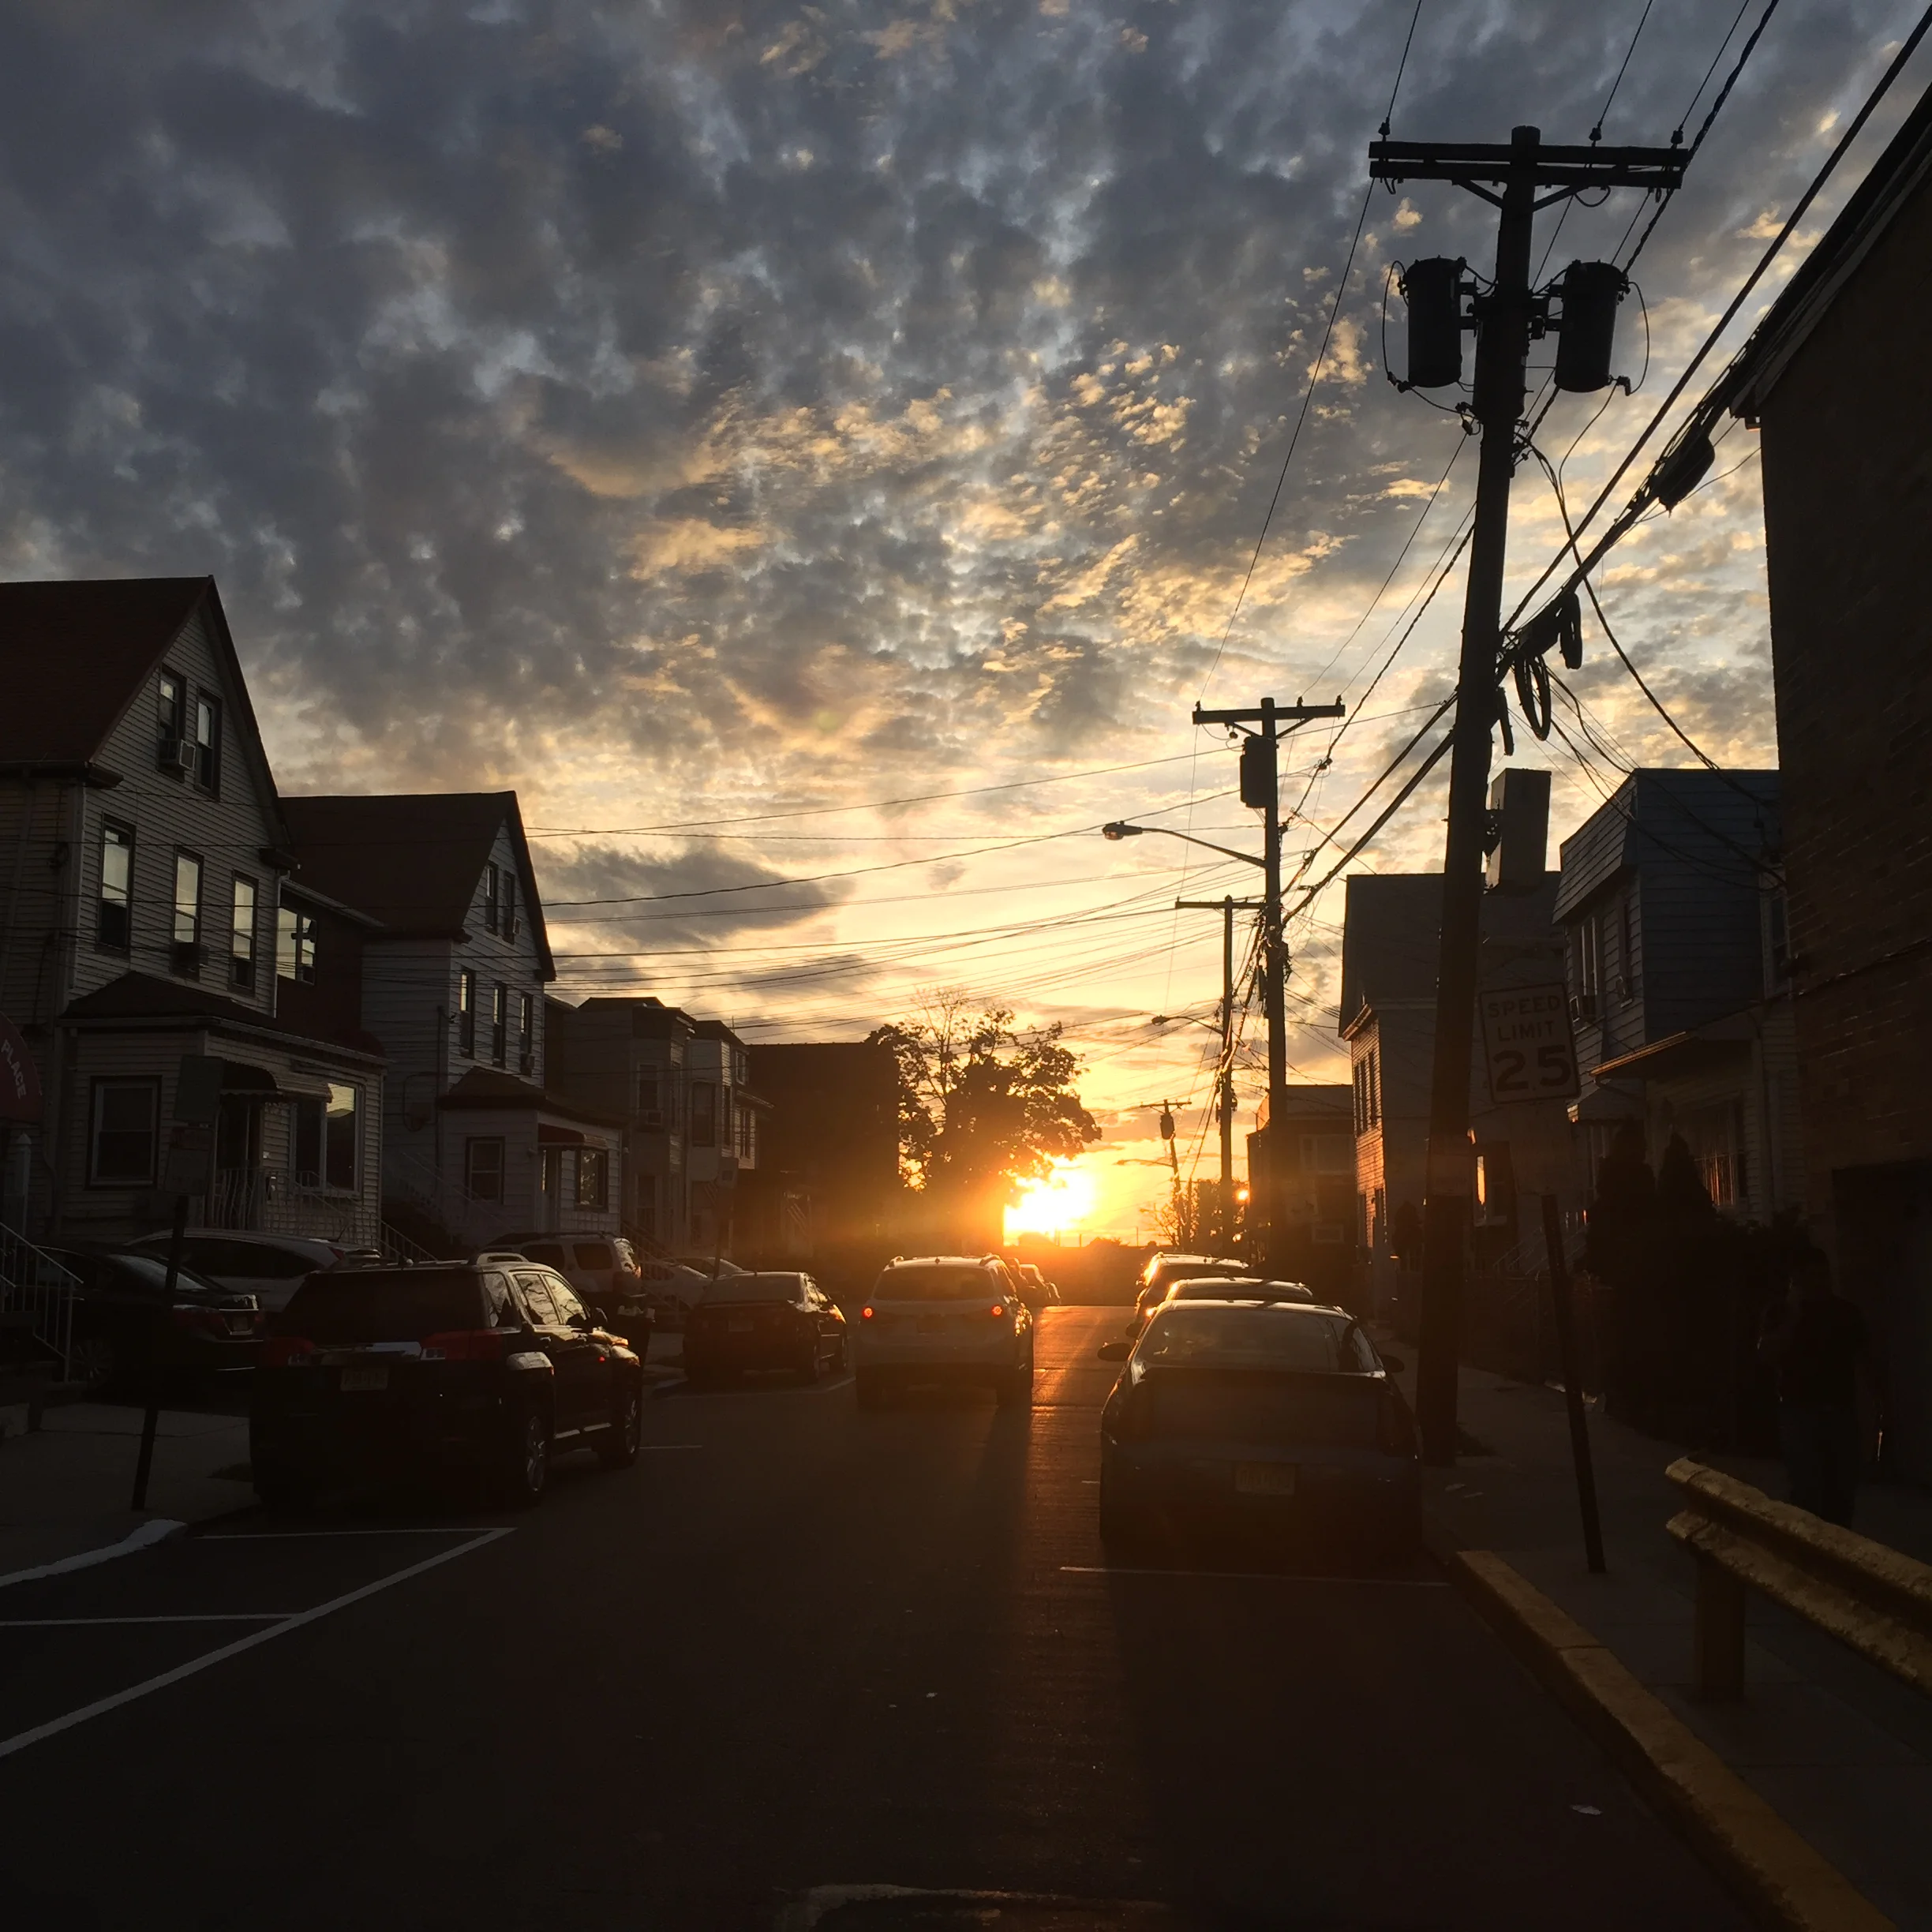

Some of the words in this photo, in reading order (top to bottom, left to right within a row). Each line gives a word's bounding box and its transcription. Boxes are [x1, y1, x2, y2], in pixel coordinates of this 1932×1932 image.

[1488, 995, 1560, 1017] SPEED
[1498, 1021, 1554, 1042] LIMIT
[1, 1039, 27, 1099] PLACE
[1493, 1045, 1571, 1091] 25
